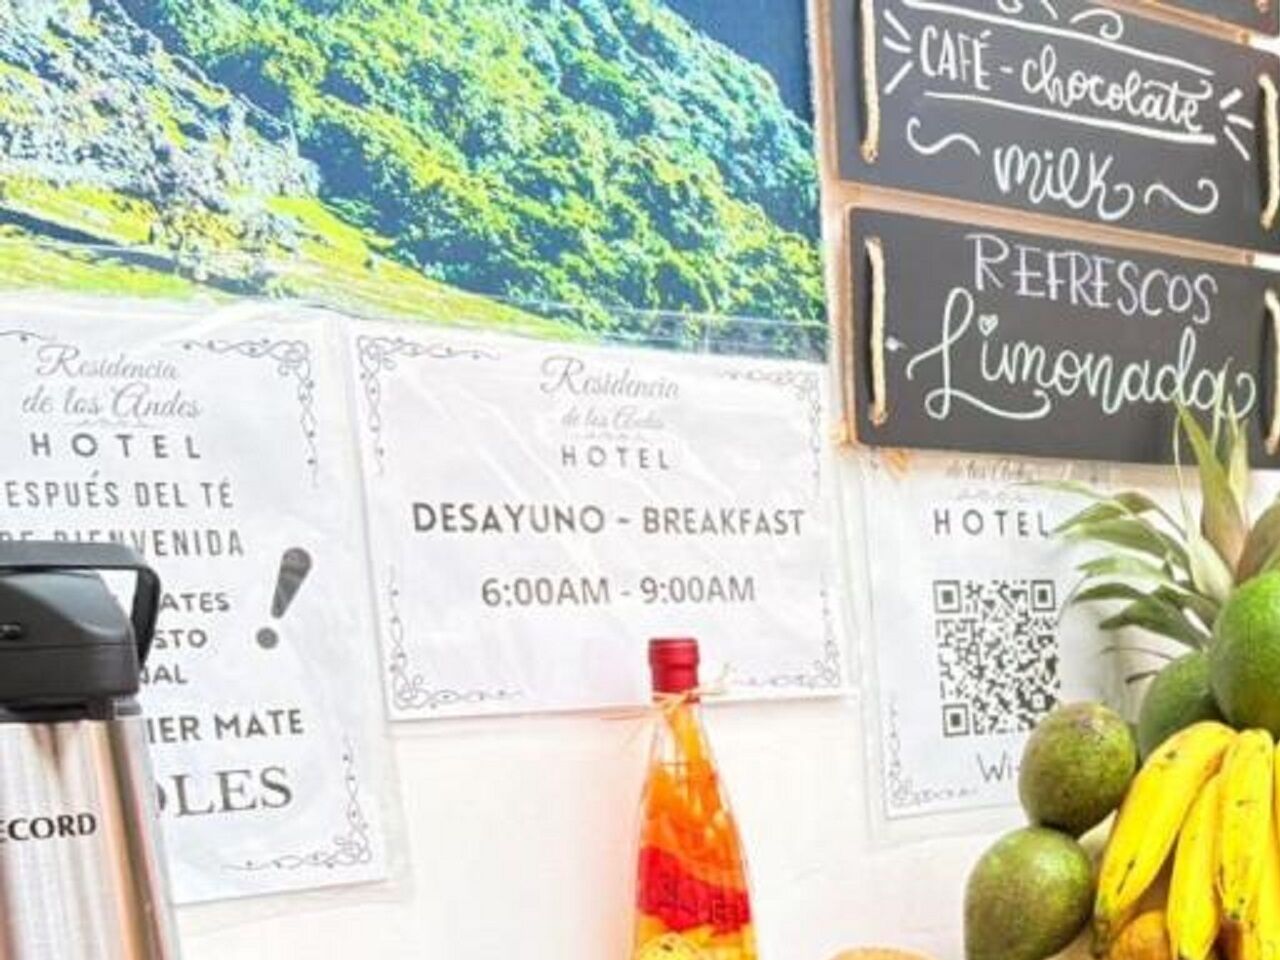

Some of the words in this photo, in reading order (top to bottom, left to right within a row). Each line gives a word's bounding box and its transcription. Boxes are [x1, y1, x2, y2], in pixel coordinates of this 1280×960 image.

[919, 25, 992, 91] CAFÉ
[1021, 44, 1213, 133] chocolate
[965, 232, 1218, 324] REFRESCOS
[36, 344, 179, 380] Residencia
[906, 286, 1256, 419] Limonada
[539, 355, 680, 399] Residencia
[22, 385, 53, 414] de
[63, 386, 102, 415] los
[111, 381, 202, 419] Andes
[29, 432, 201, 459] HOTEL
[561, 445, 669, 470] HOTEL
[4, 469, 120, 509] ESPUÉS
[134, 480, 188, 509] DEL
[199, 476, 234, 509] TÉ
[412, 501, 605, 534] DESAYUNO
[643, 506, 806, 536] BREAKFAST
[933, 508, 1051, 538] HOTEL
[159, 592, 231, 613] ATES
[480, 576, 611, 608] 6:00AM
[639, 575, 756, 605] 9:00AM
[153, 628, 209, 649] STO
[147, 714, 202, 744] IER
[213, 708, 304, 740] MATE
